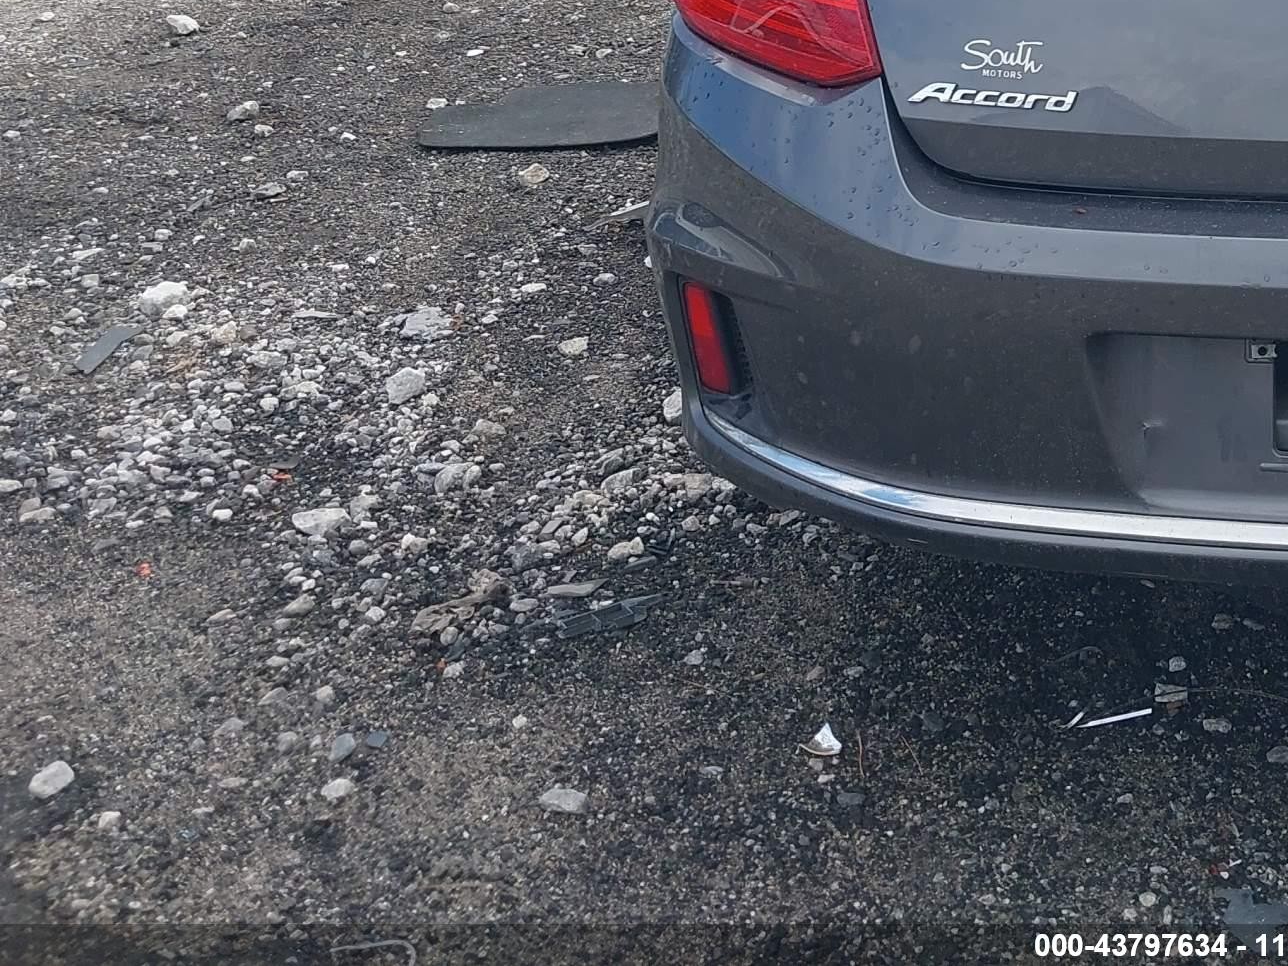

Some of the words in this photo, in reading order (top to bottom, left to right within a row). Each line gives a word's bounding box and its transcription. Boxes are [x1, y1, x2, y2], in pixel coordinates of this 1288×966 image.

[960, 39, 1044, 74] South
[981, 68, 1024, 80] MOTORS
[907, 82, 1079, 113] Accord
